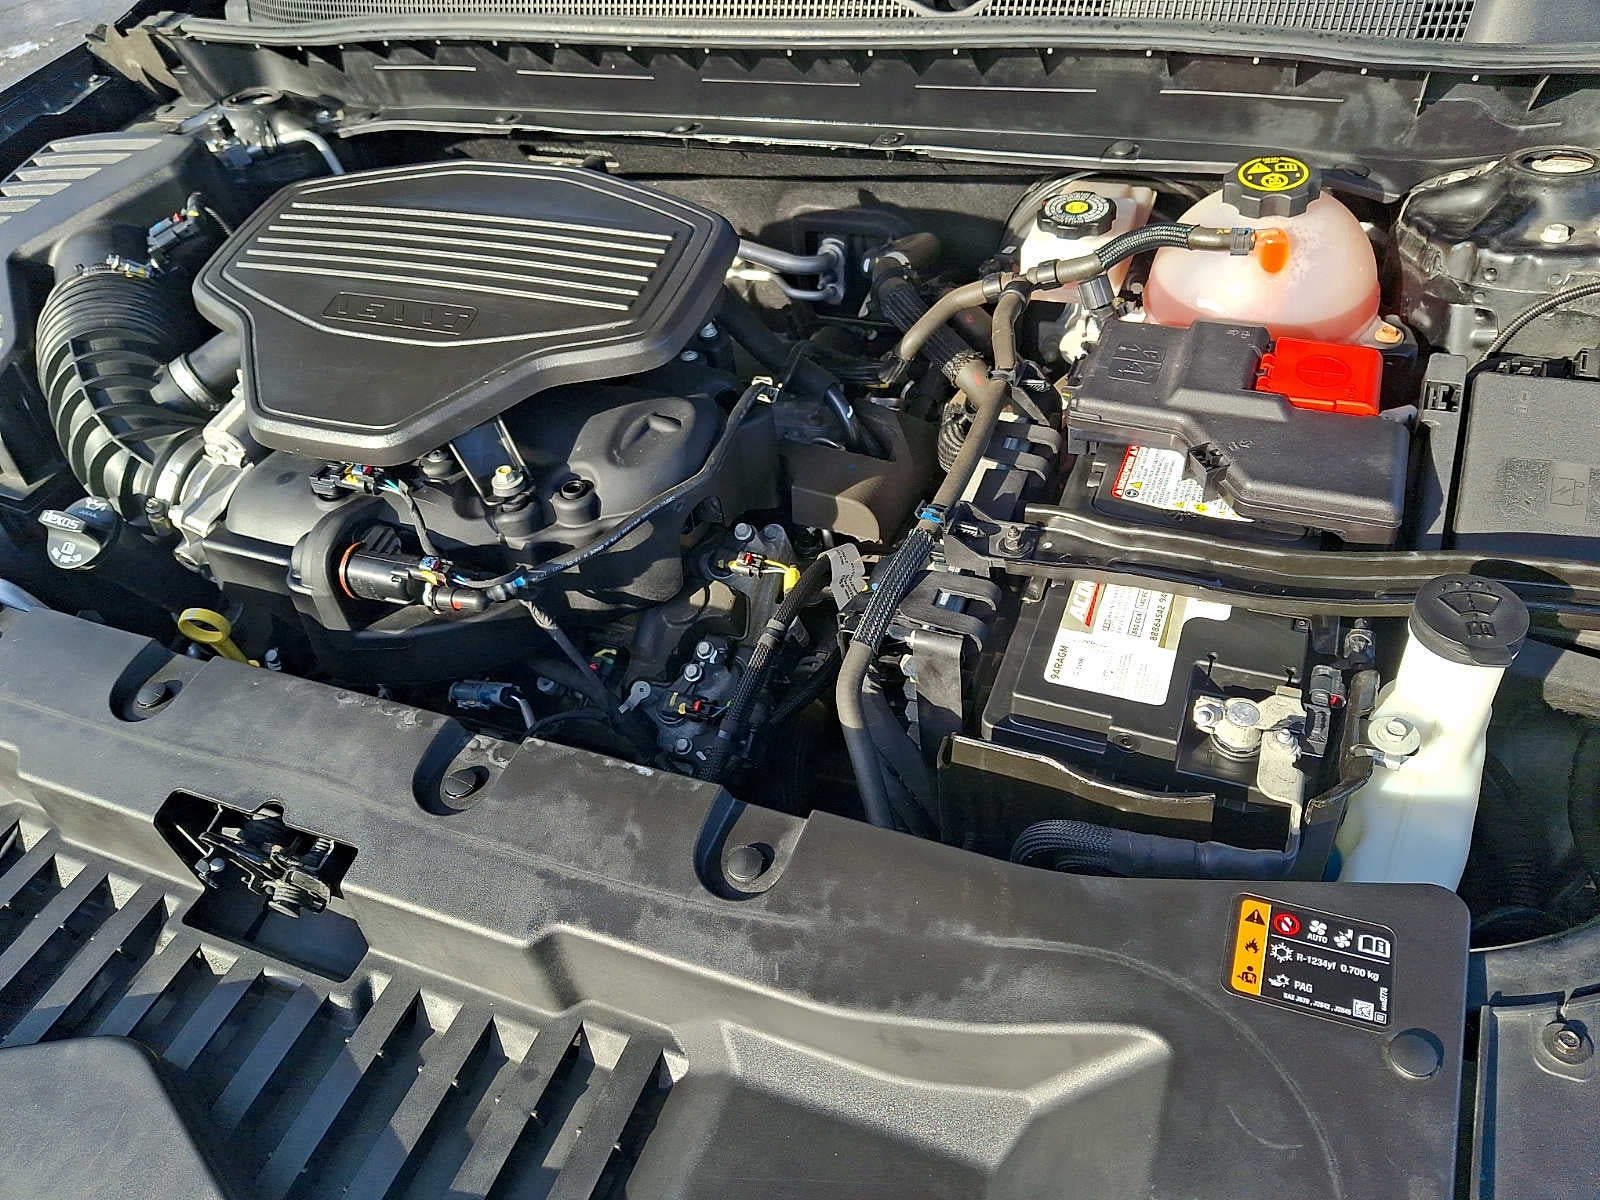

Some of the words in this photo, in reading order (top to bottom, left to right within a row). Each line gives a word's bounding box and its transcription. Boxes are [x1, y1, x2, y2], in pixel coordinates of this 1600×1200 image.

[42, 511, 79, 529] dexos
[1050, 644, 1069, 680] 94RAGM
[1307, 933, 1328, 944] AUTO
[1296, 953, 1337, 971] R-1234yf
[1340, 964, 1366, 978] 0.700
[1367, 970, 1380, 982] kg
[1294, 980, 1313, 993] PAG
